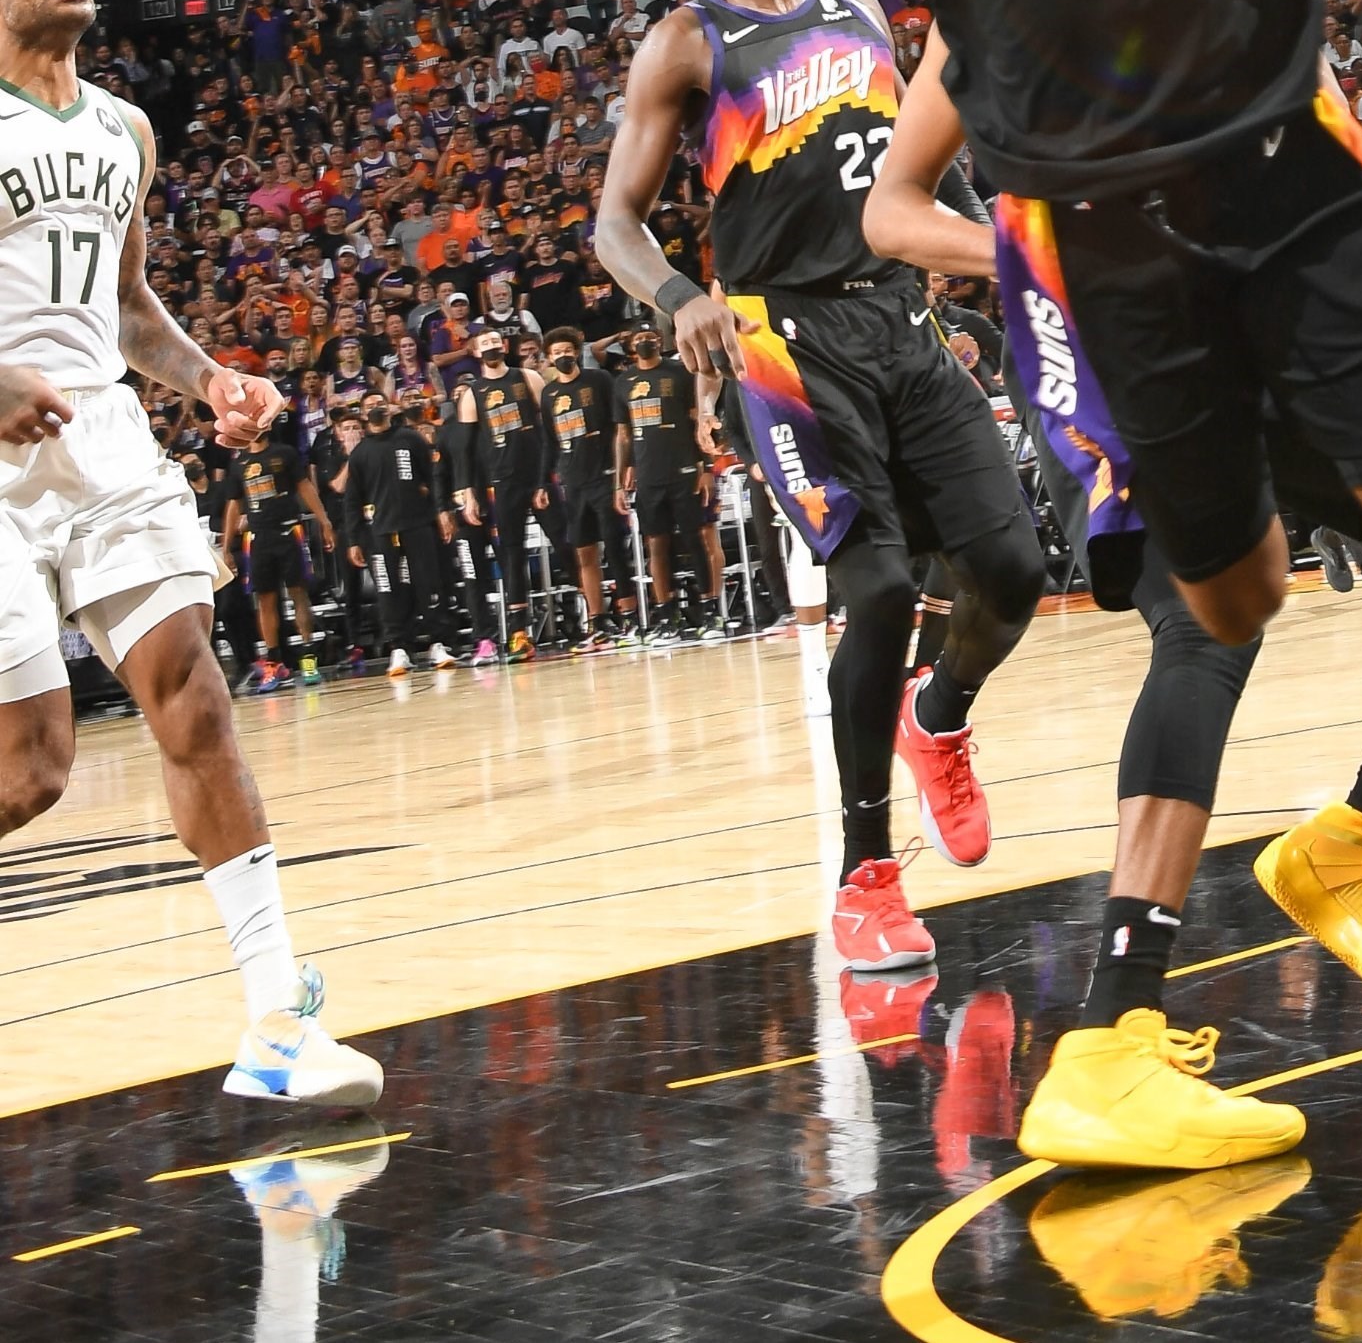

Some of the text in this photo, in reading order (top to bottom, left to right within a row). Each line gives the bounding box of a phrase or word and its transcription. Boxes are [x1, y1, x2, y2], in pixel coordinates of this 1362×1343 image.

[756, 46, 876, 135] Valley
[786, 66, 807, 84] THE
[1, 152, 135, 223] BUCKS
[48, 230, 100, 304] 17
[1023, 289, 1079, 415] SUNS
[395, 448, 413, 480] SUNS
[769, 424, 813, 495] SUNS
